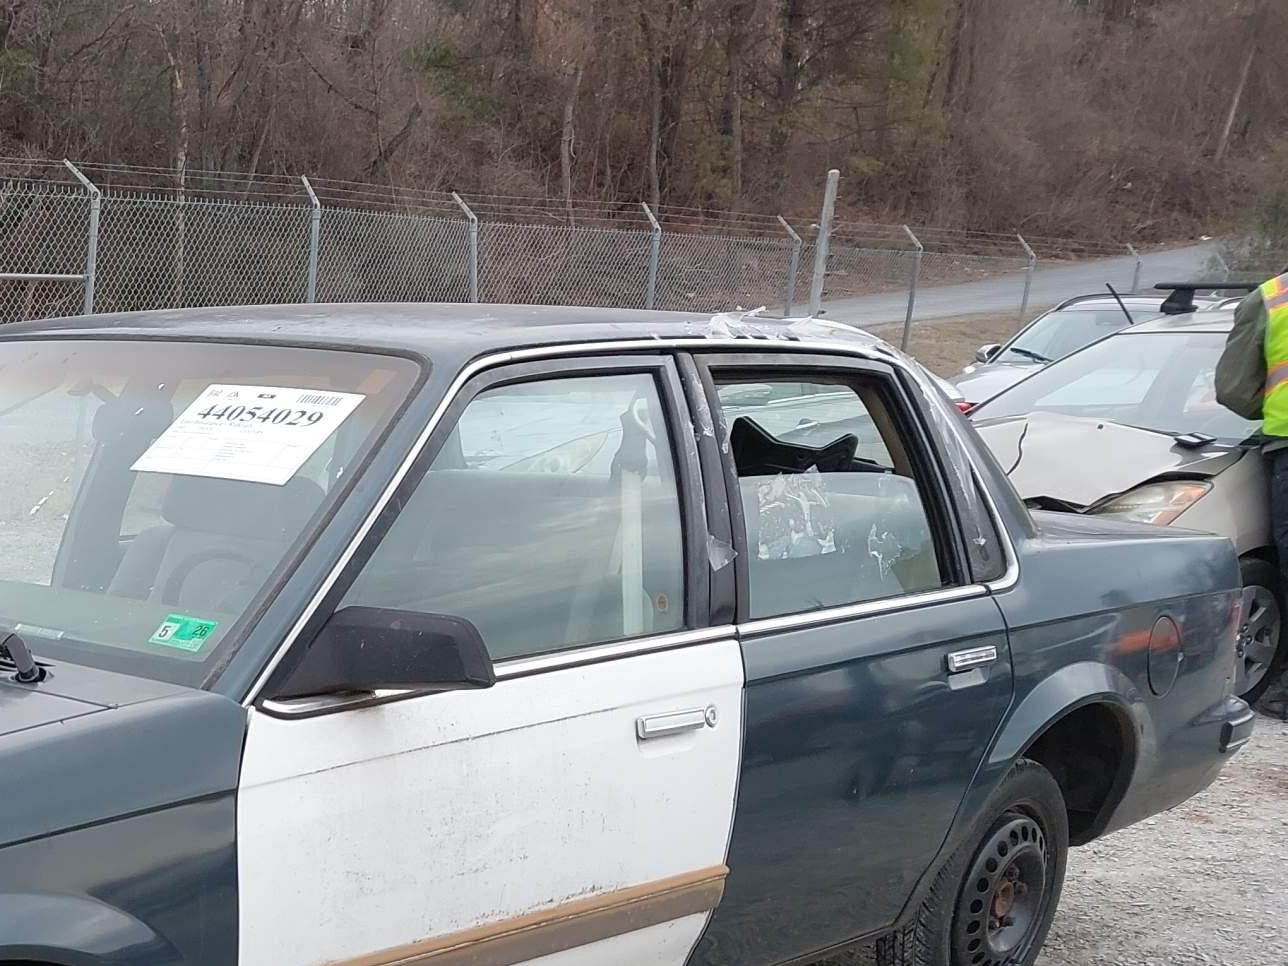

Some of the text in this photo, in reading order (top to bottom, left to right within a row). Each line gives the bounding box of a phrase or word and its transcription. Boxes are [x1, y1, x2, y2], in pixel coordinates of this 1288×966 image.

[197, 403, 324, 427] 44054029
[158, 625, 210, 638] 5 26
